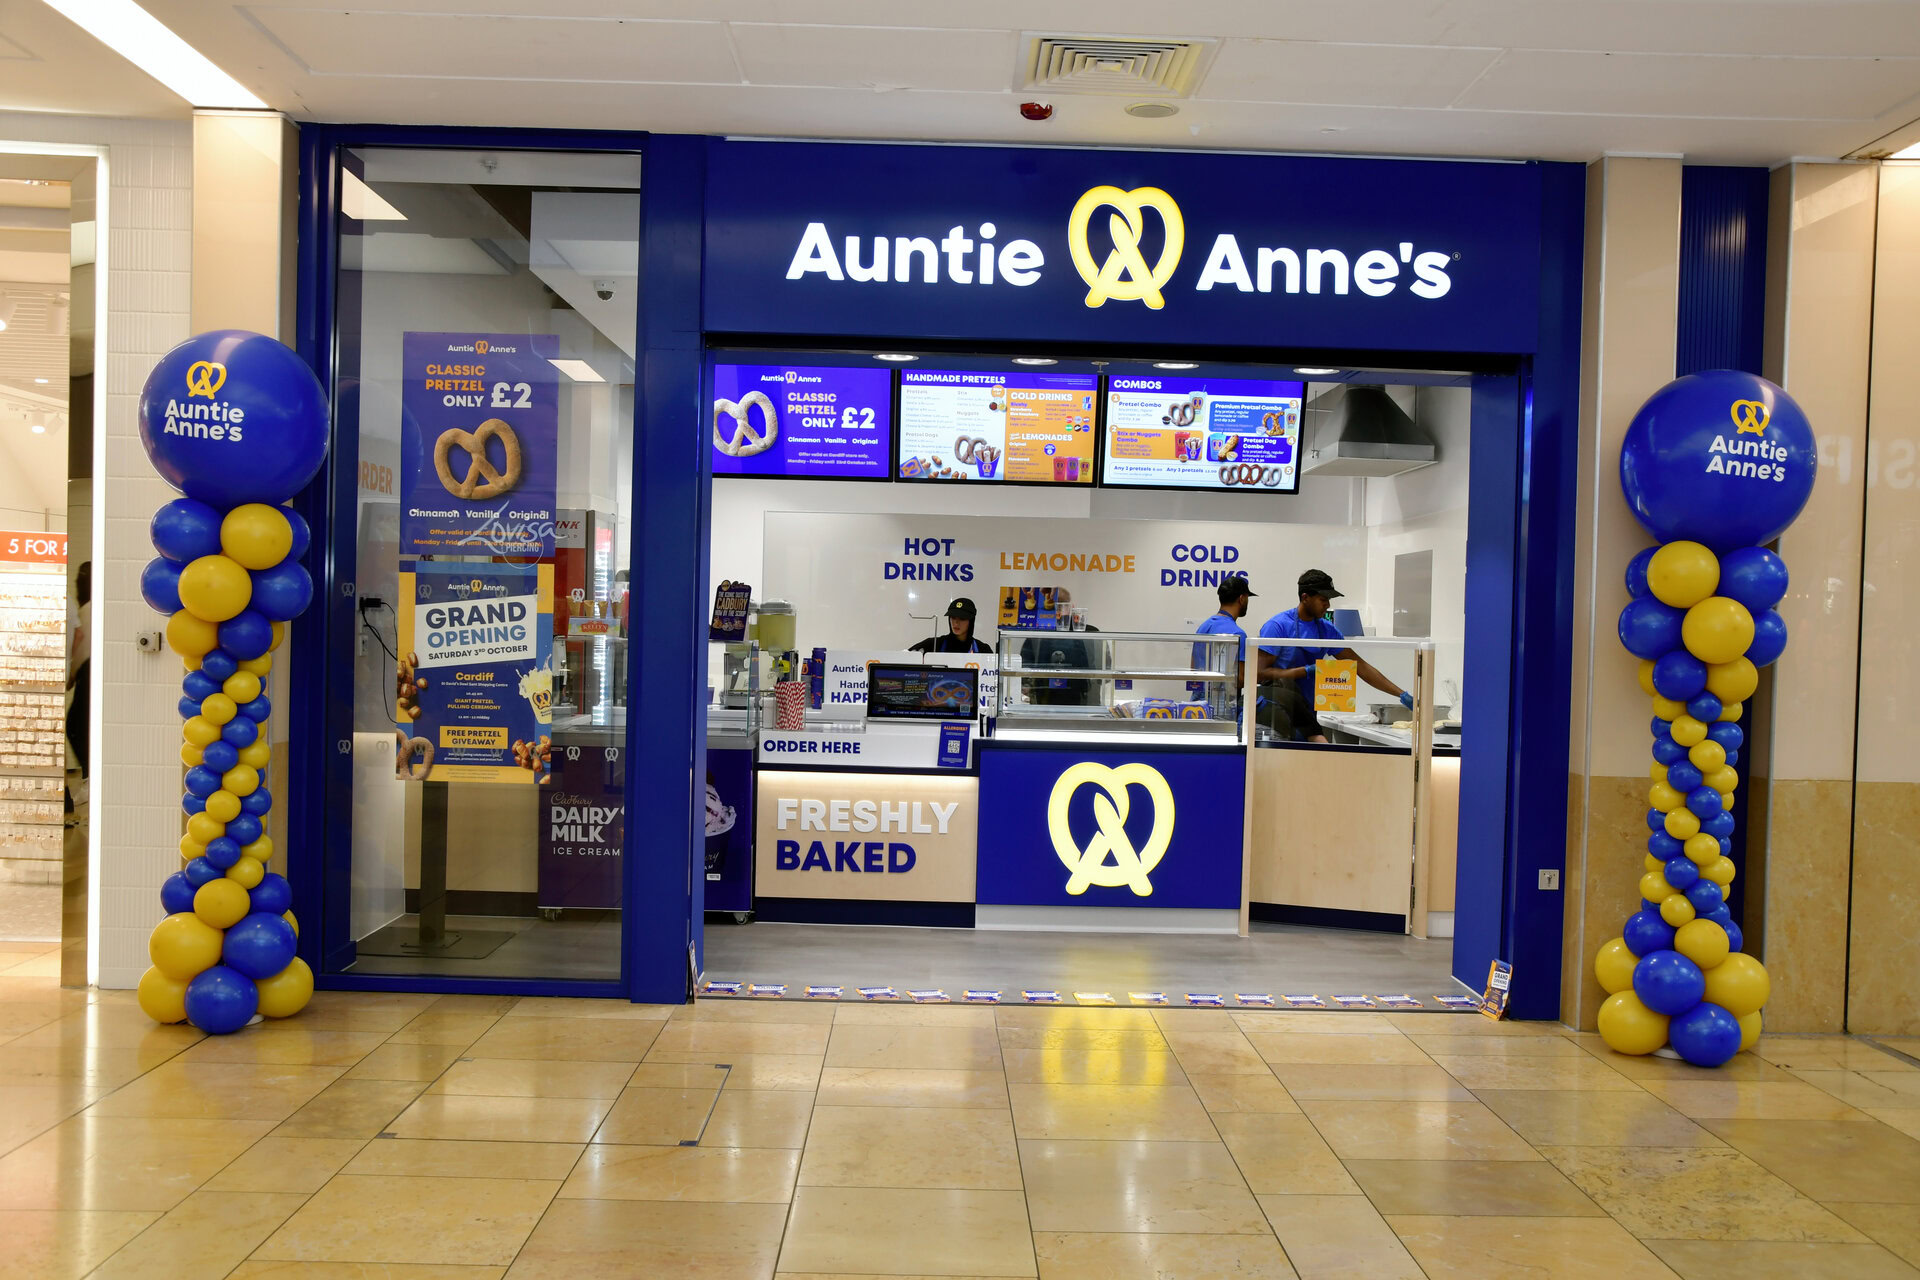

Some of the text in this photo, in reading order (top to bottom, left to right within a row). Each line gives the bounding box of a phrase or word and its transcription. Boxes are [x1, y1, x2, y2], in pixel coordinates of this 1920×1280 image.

[785, 222, 1452, 299] Auntie Anne's
[448, 344, 516, 353] Auntie Anne's
[426, 364, 485, 376] CLASSIC
[425, 379, 485, 391] PRETZEL
[760, 374, 785, 382] Auntie
[906, 373, 1006, 385] HANDMADE PRETZELS
[1113, 379, 1162, 390] COMBOS
[443, 381, 532, 408] ONLY £2
[787, 392, 837, 403] CLASSIC
[1011, 391, 1036, 401] COLD
[1038, 392, 1073, 402] DRINKS
[165, 399, 245, 424] Auntie
[787, 404, 837, 415] PRETZEL
[801, 407, 875, 429] ONLY £2
[164, 416, 243, 442] Anne's
[787, 436, 821, 444] Cinnamon
[851, 438, 879, 446] Original
[1021, 433, 1073, 441] LEMONADES
[1708, 435, 1788, 462] Auntie
[1705, 455, 1786, 482] Anne's
[357, 460, 393, 495] RDER
[409, 508, 549, 522] Cinnamon Vanilla Original
[457, 500, 569, 554] Lovisa
[8, 538, 58, 555] 5 FOR
[413, 539, 441, 547] Monday
[445, 539, 465, 547] Friday
[505, 543, 540, 553] PIERCING
[904, 537, 955, 556] HOT
[1171, 544, 1239, 563] COLD
[1000, 552, 1136, 573] LEMONADE
[884, 562, 974, 582] DRINKS
[448, 583, 505, 592] Auntie Anne's
[716, 598, 748, 610] CADBURY
[425, 601, 527, 629] GRAND
[427, 624, 526, 648] OPENING
[428, 645, 528, 660] SATURDAY 3RD OCTOBER
[832, 664, 864, 672] Auntie
[455, 672, 495, 681] Cardiff
[447, 729, 501, 738] FREE PRETZEL
[763, 739, 861, 754] ORDER HERE
[551, 792, 593, 808] Cadbury
[551, 806, 620, 825] DAIRY
[777, 798, 960, 835] FRESHLY
[551, 824, 606, 843] MILK
[553, 847, 621, 857] ICE CREAM
[776, 839, 917, 874] BAKED
